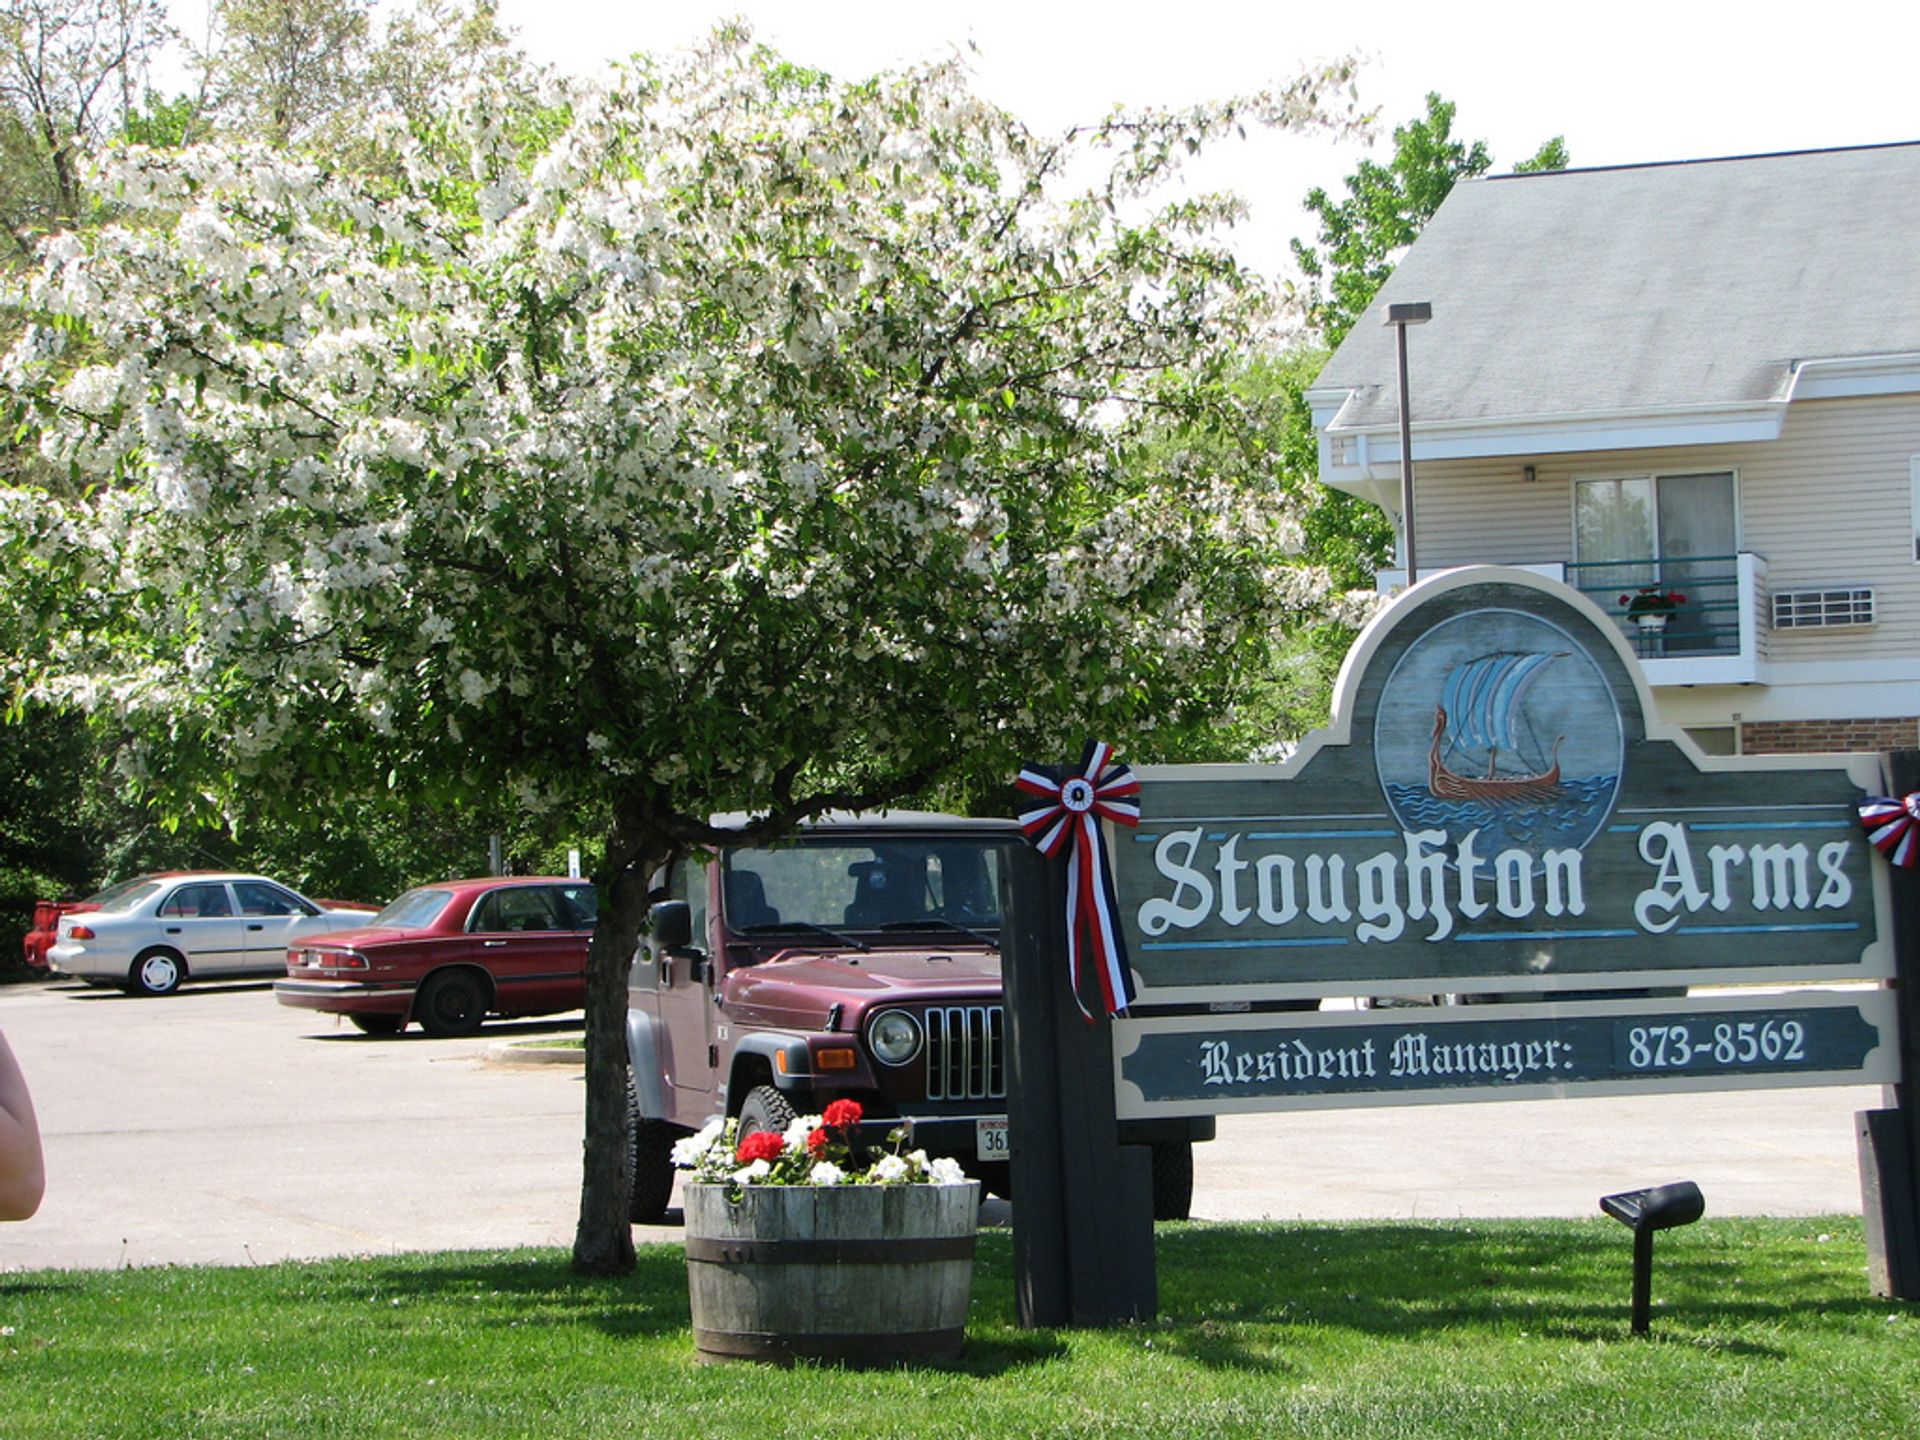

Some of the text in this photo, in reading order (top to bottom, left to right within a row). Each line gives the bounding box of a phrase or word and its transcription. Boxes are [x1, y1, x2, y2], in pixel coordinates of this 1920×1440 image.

[1137, 820, 1852, 944] Stoughton Arms
[1200, 1020, 1805, 1086] Resident Manager: 873-8562
